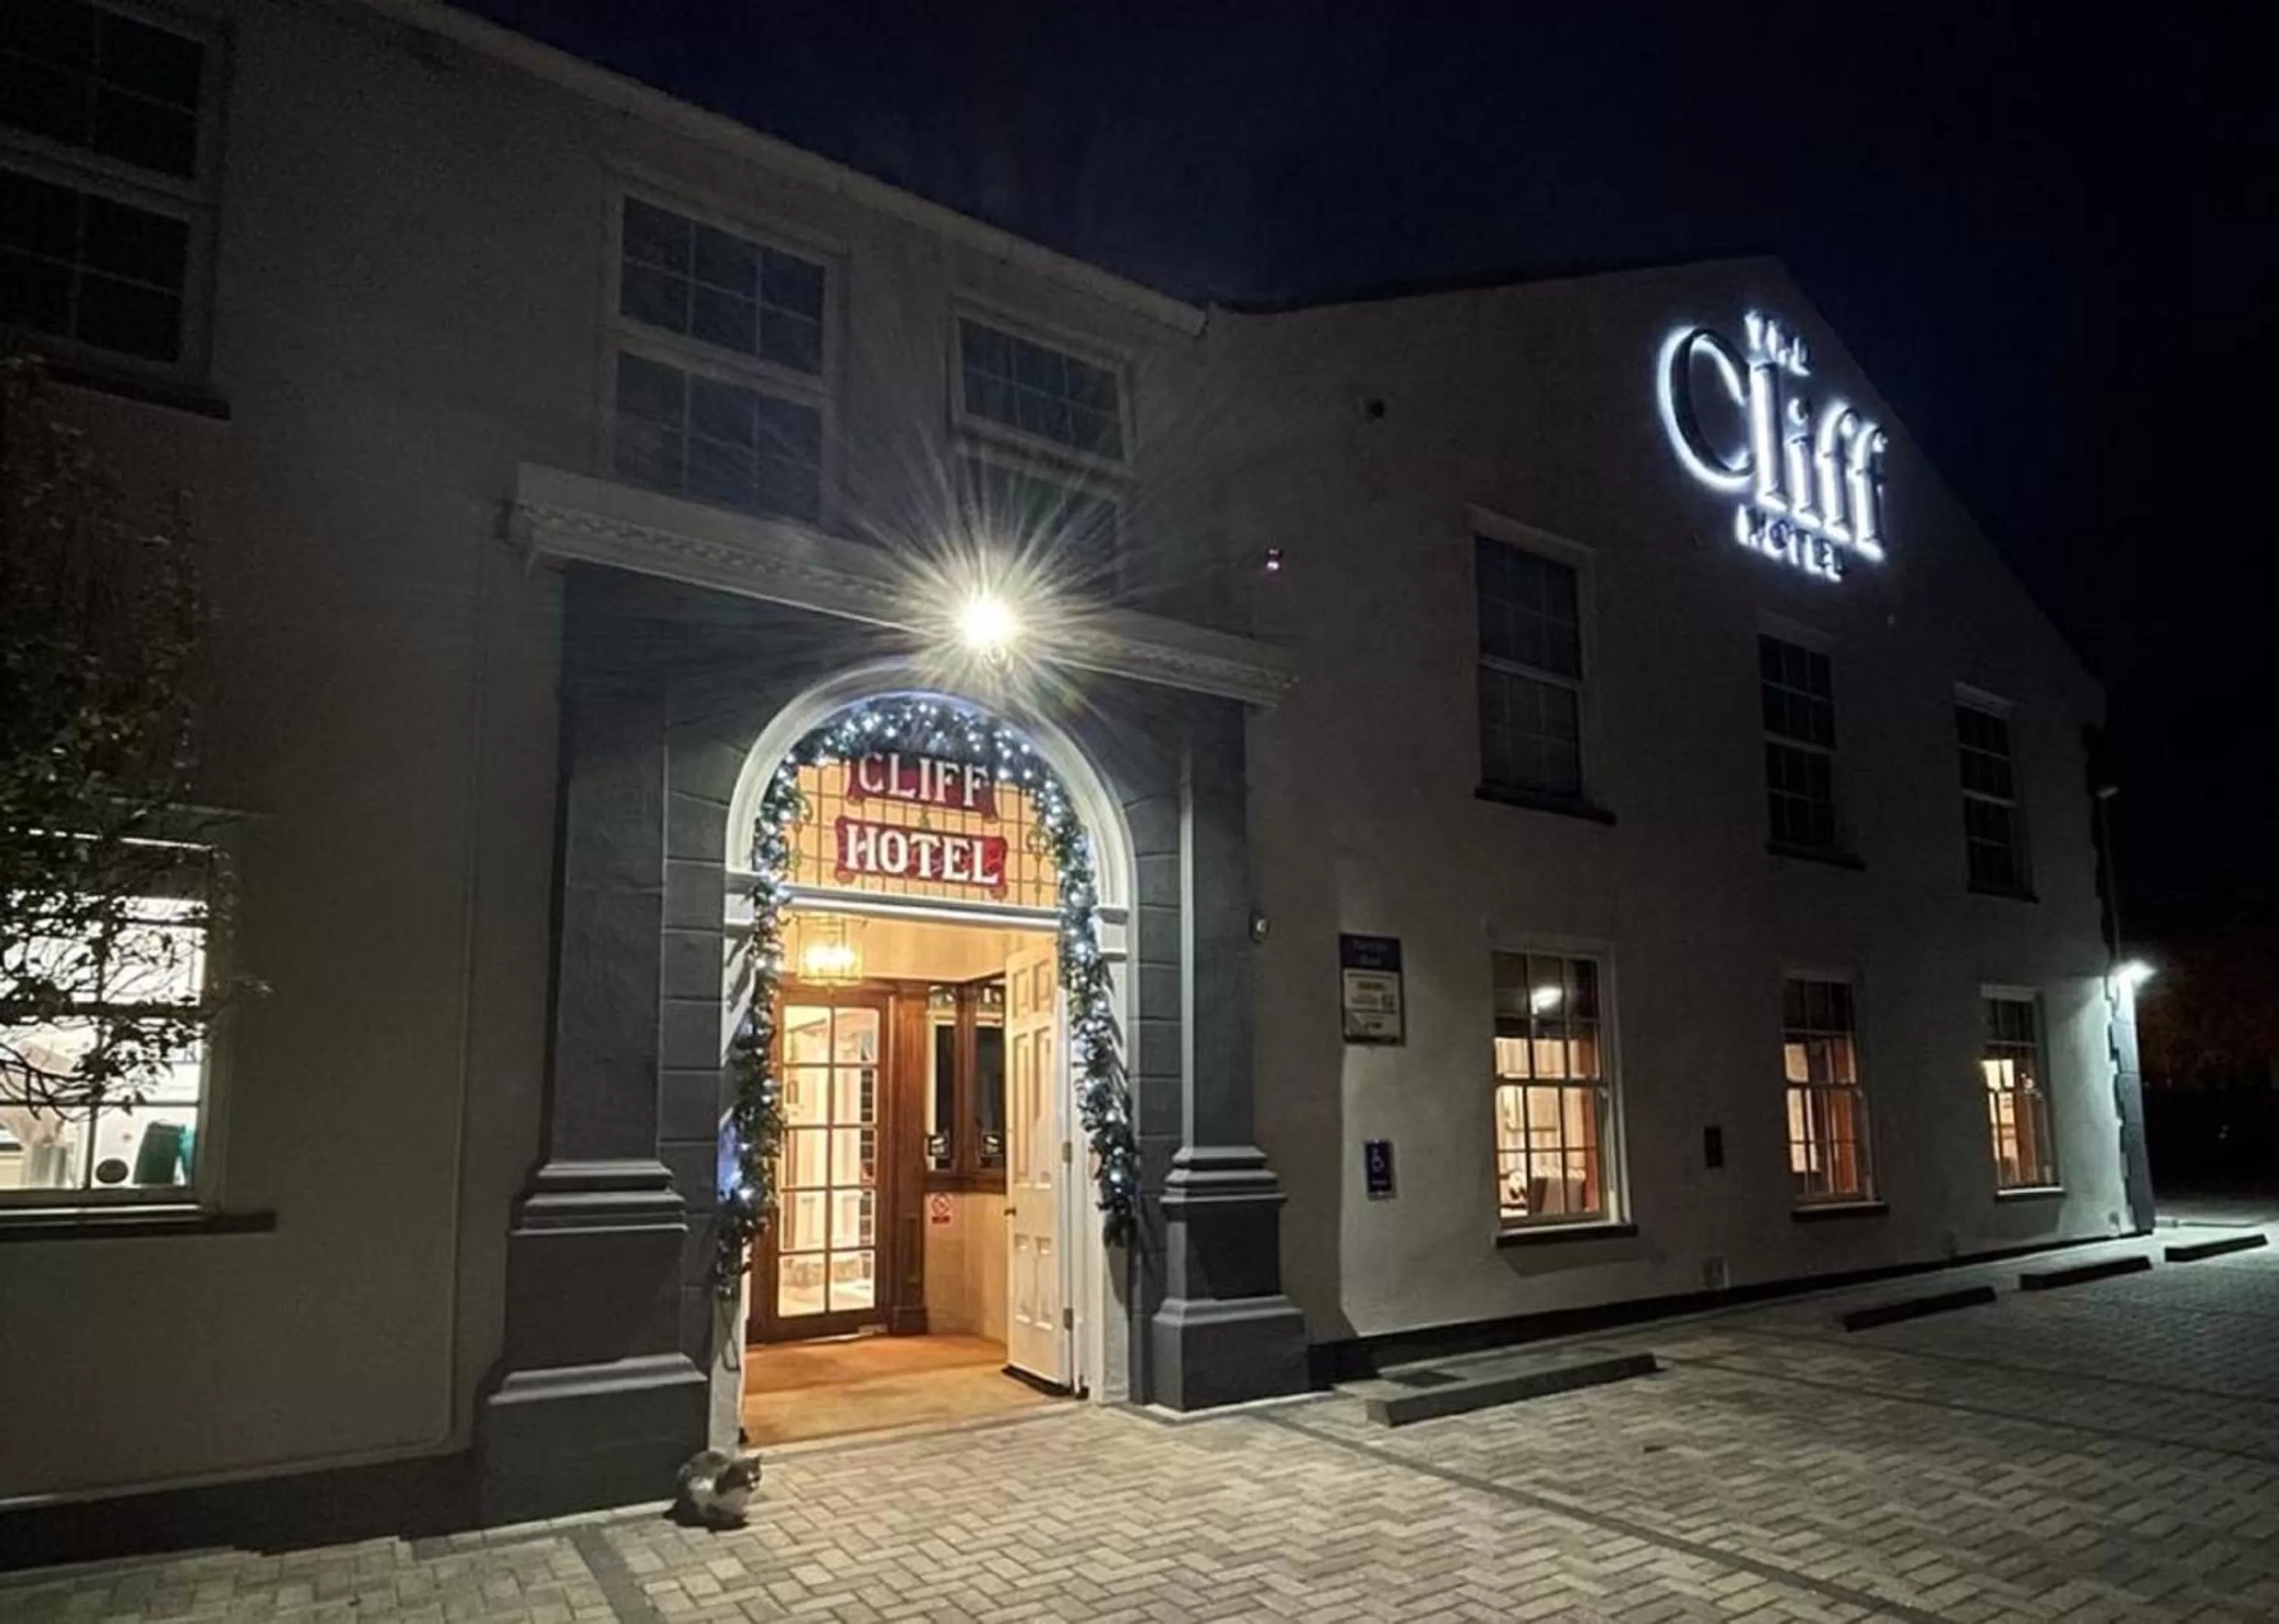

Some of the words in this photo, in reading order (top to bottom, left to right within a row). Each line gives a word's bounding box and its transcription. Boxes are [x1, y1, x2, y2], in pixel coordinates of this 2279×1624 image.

[1657, 325, 1890, 562] Cliff
[1736, 503, 1851, 583] HOTEL
[858, 752, 989, 807] CLIFF
[845, 823, 999, 884] HOTEL
